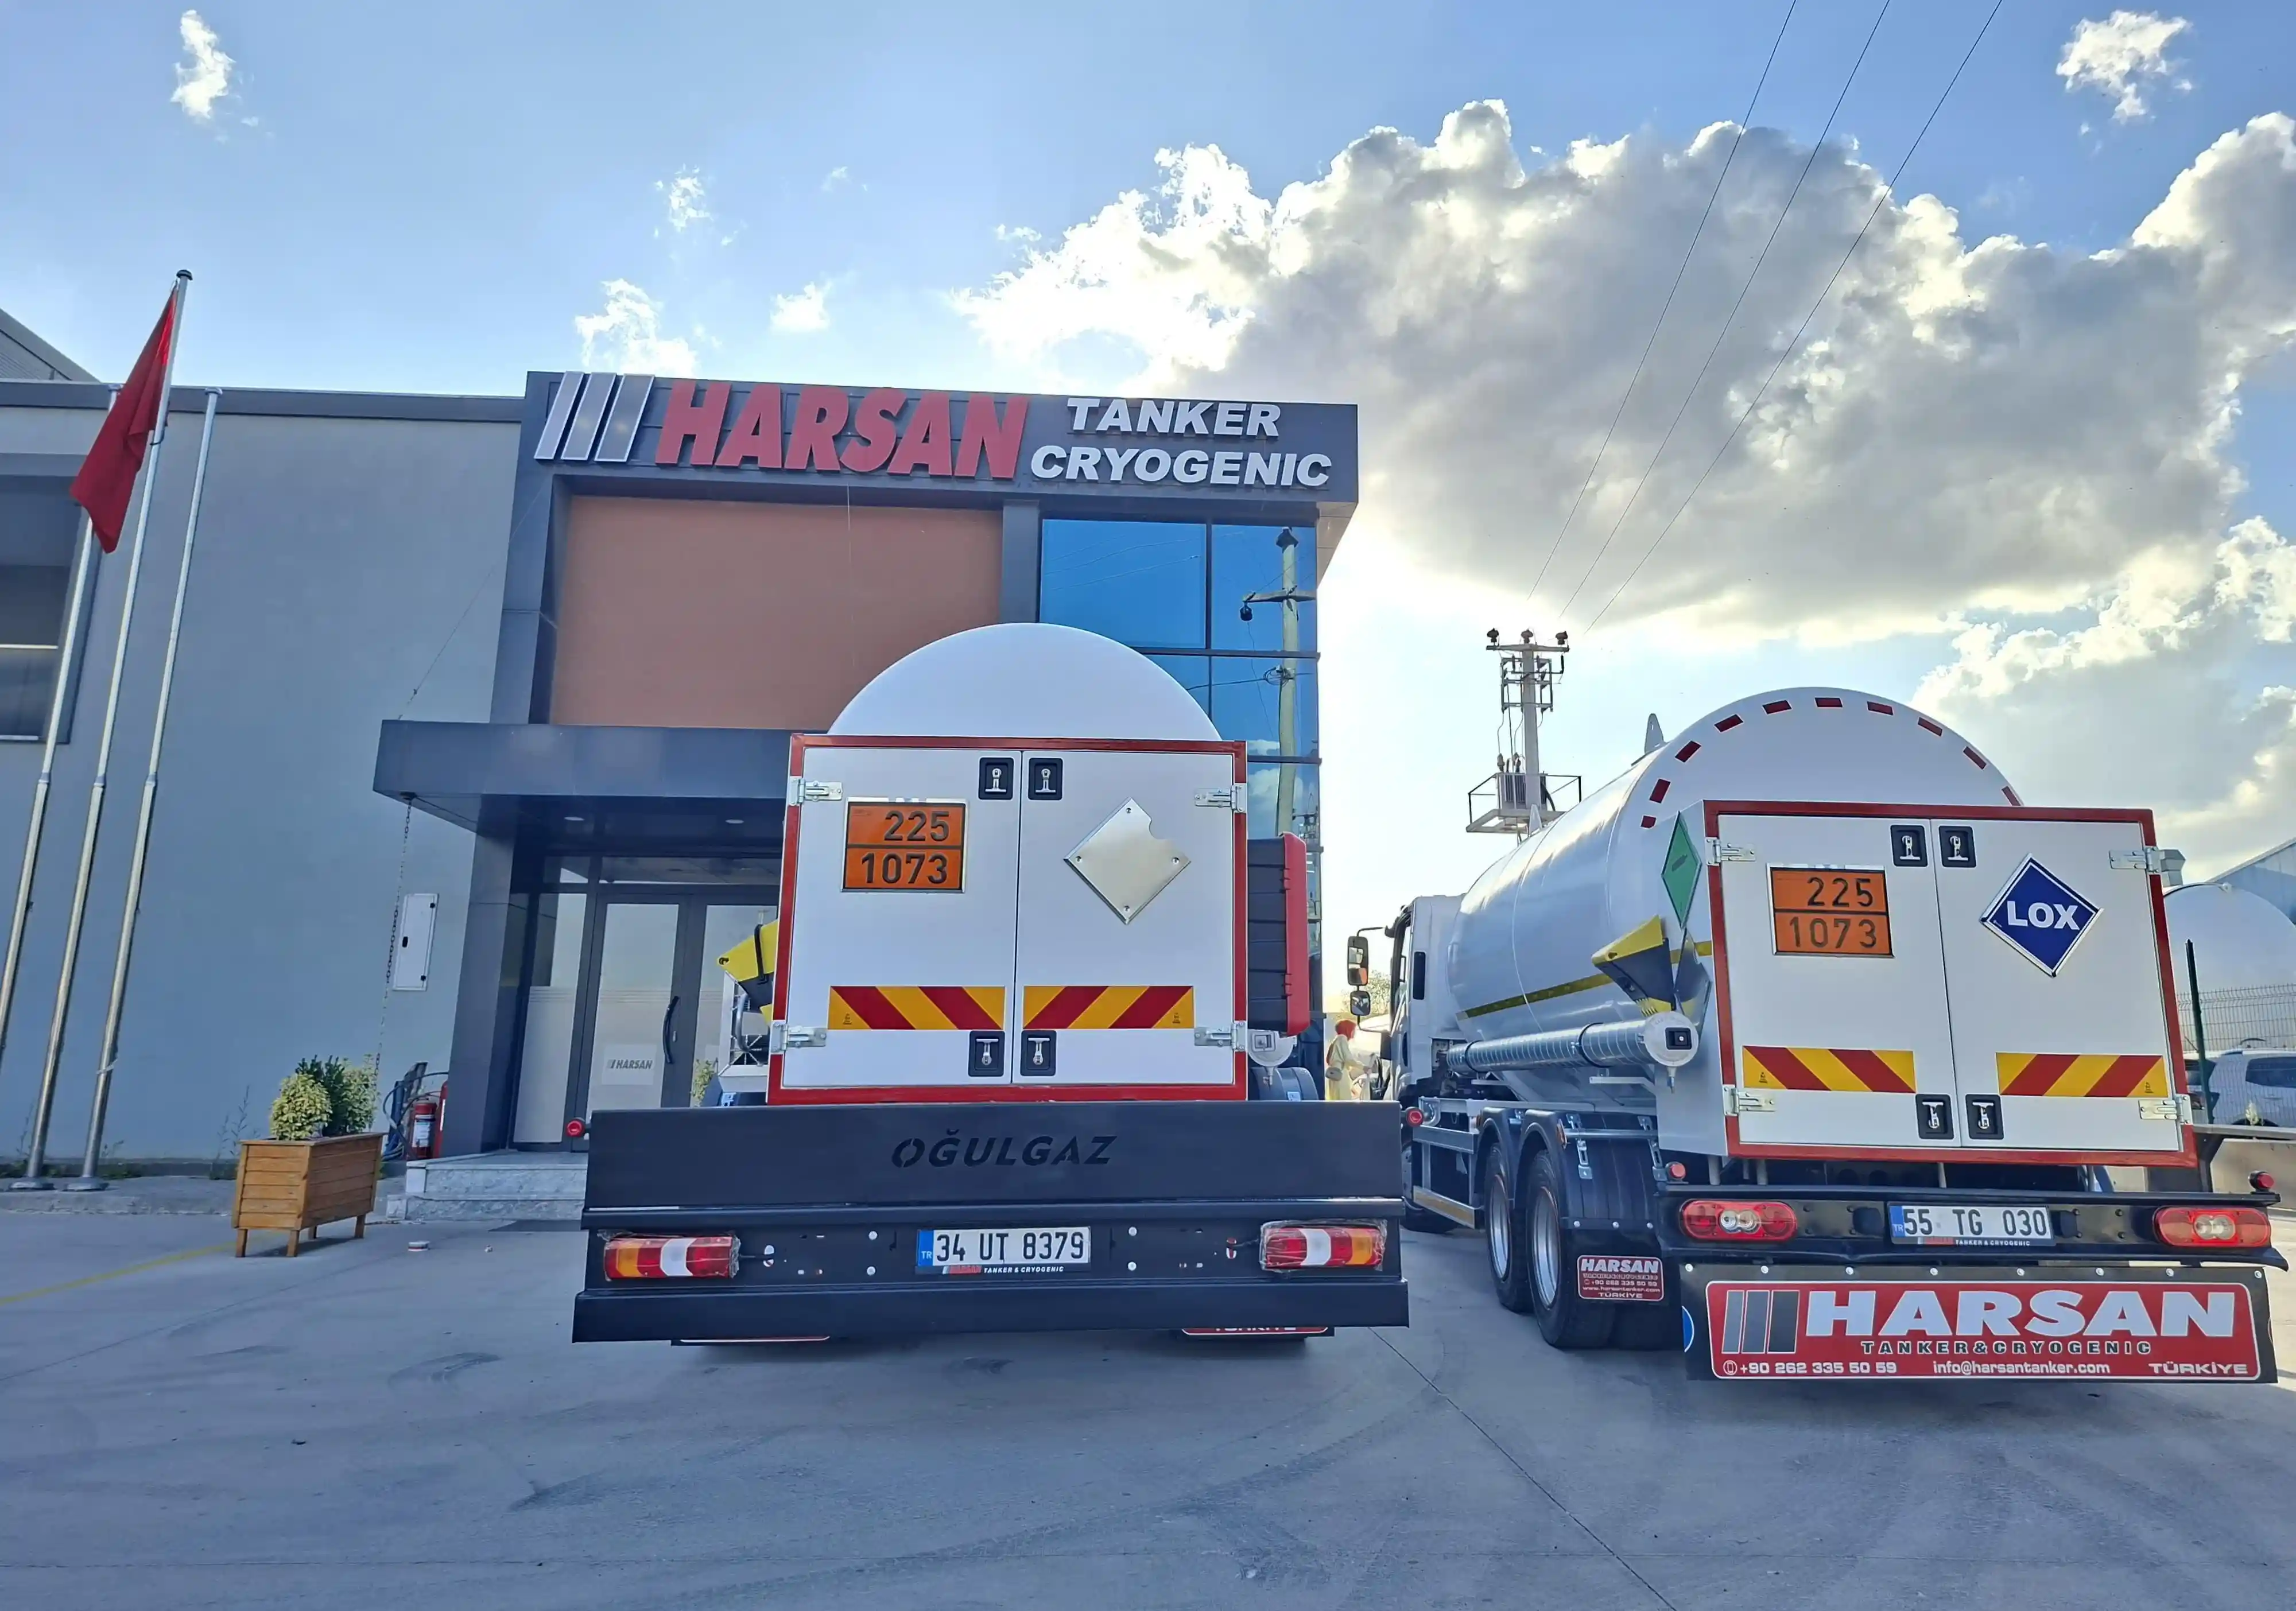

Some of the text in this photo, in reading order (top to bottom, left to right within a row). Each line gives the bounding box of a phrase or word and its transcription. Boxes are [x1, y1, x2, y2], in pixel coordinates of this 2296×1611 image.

[654, 379, 1029, 479] HARSAN
[1066, 397, 1281, 438] TANKER
[1030, 445, 1332, 487] CRYOGENIC
[884, 810, 950, 842] 225
[861, 852, 948, 884] 1073
[1806, 876, 1874, 907] 225
[2007, 900, 2080, 930] LOX
[1789, 916, 1877, 949] 1073
[615, 1059, 653, 1069] HARSAN
[891, 1128, 1118, 1168] OĞULGAZ
[1892, 1223, 1904, 1233] TR
[1903, 1208, 2047, 1236] 55 TG 030
[921, 1251, 932, 1259] TR
[936, 1231, 1084, 1262] 34 UT 8379
[1581, 1258, 1659, 1274] HARSAN
[1805, 1290, 2235, 1337] HARSAN
[1861, 1340, 2152, 1355] TANKER&CRYOGENIC
[1740, 1361, 1897, 1374] +90 262 335 50 59
[1933, 1360, 2111, 1375] info@harsantanker.com
[2148, 1361, 2250, 1375] TÜRKİYE
